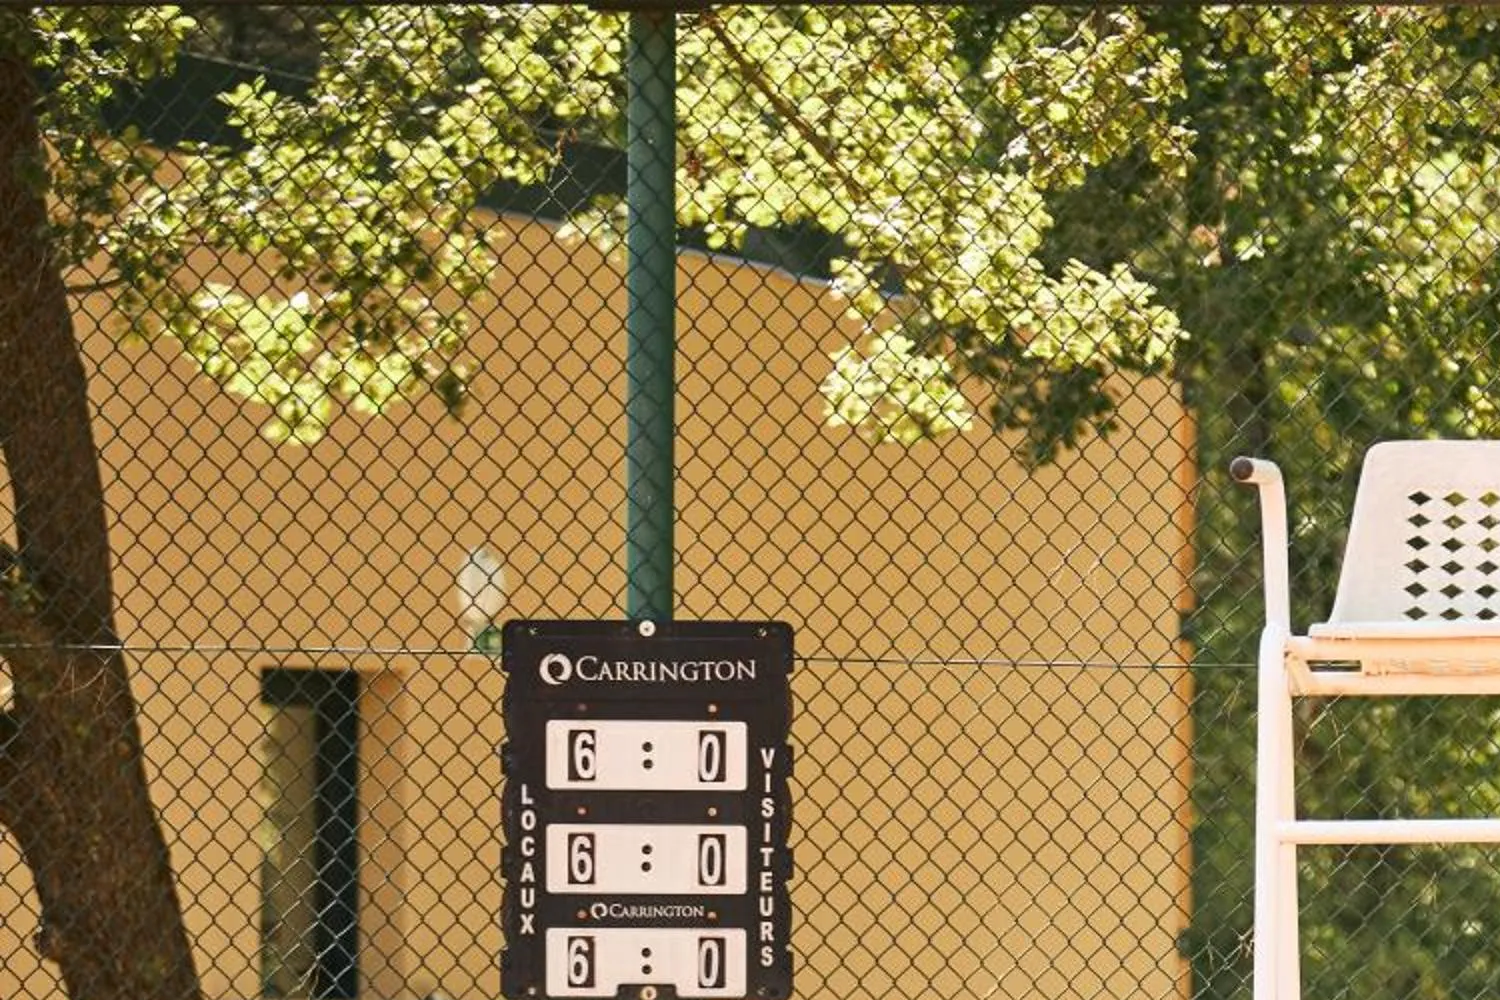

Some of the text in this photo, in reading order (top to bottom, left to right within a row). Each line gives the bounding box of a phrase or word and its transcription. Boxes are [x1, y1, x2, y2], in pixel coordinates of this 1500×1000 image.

[576, 655, 756, 682] CARRINGTON
[573, 731, 596, 779] 6
[699, 733, 721, 782] 0
[519, 784, 537, 934] LOCAUX
[571, 836, 594, 883] 6
[700, 837, 721, 887] 0
[760, 748, 775, 967] VISITEURS
[609, 903, 704, 919] CARRINGTON
[568, 938, 590, 985] 6
[699, 940, 720, 988] 0
